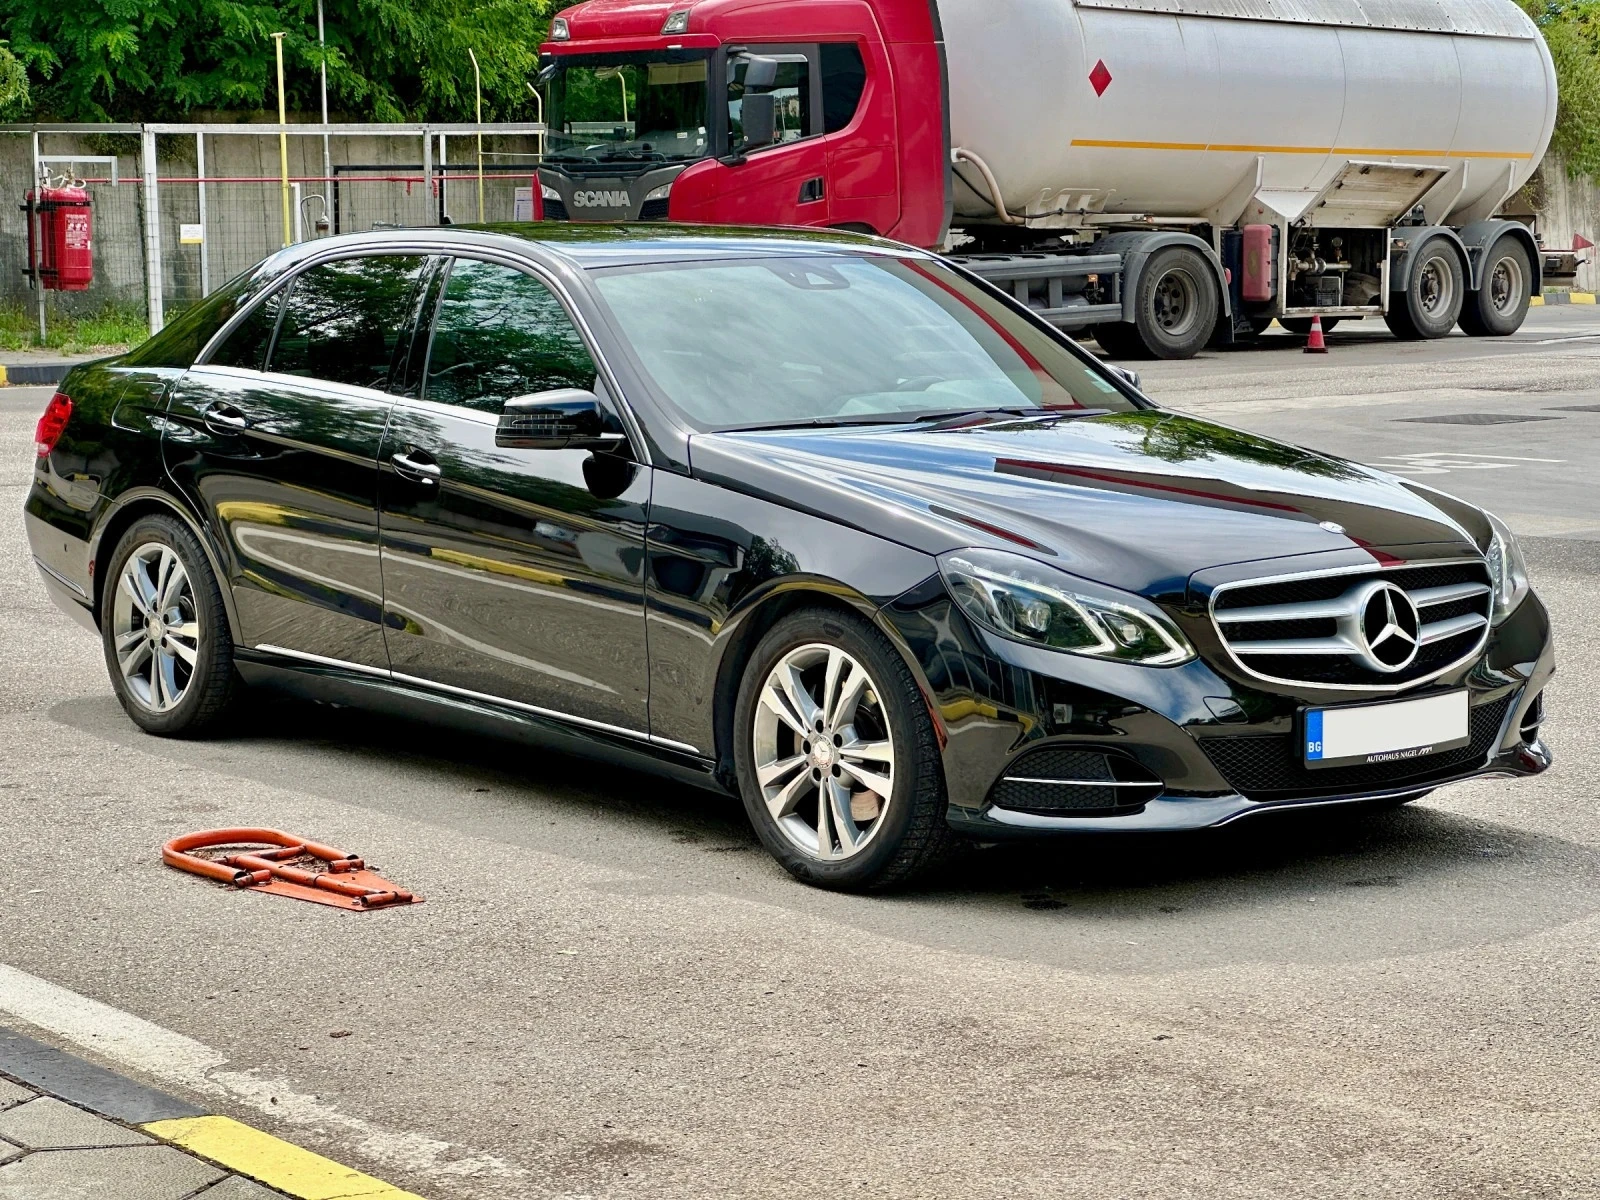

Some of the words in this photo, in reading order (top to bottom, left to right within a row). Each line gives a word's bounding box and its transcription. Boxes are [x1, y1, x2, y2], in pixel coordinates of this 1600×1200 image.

[573, 190, 631, 208] SCANIA
[1308, 742, 1321, 752] BG
[1366, 752, 1399, 763] AUTOHAUS
[1400, 750, 1417, 758] NAGEL
